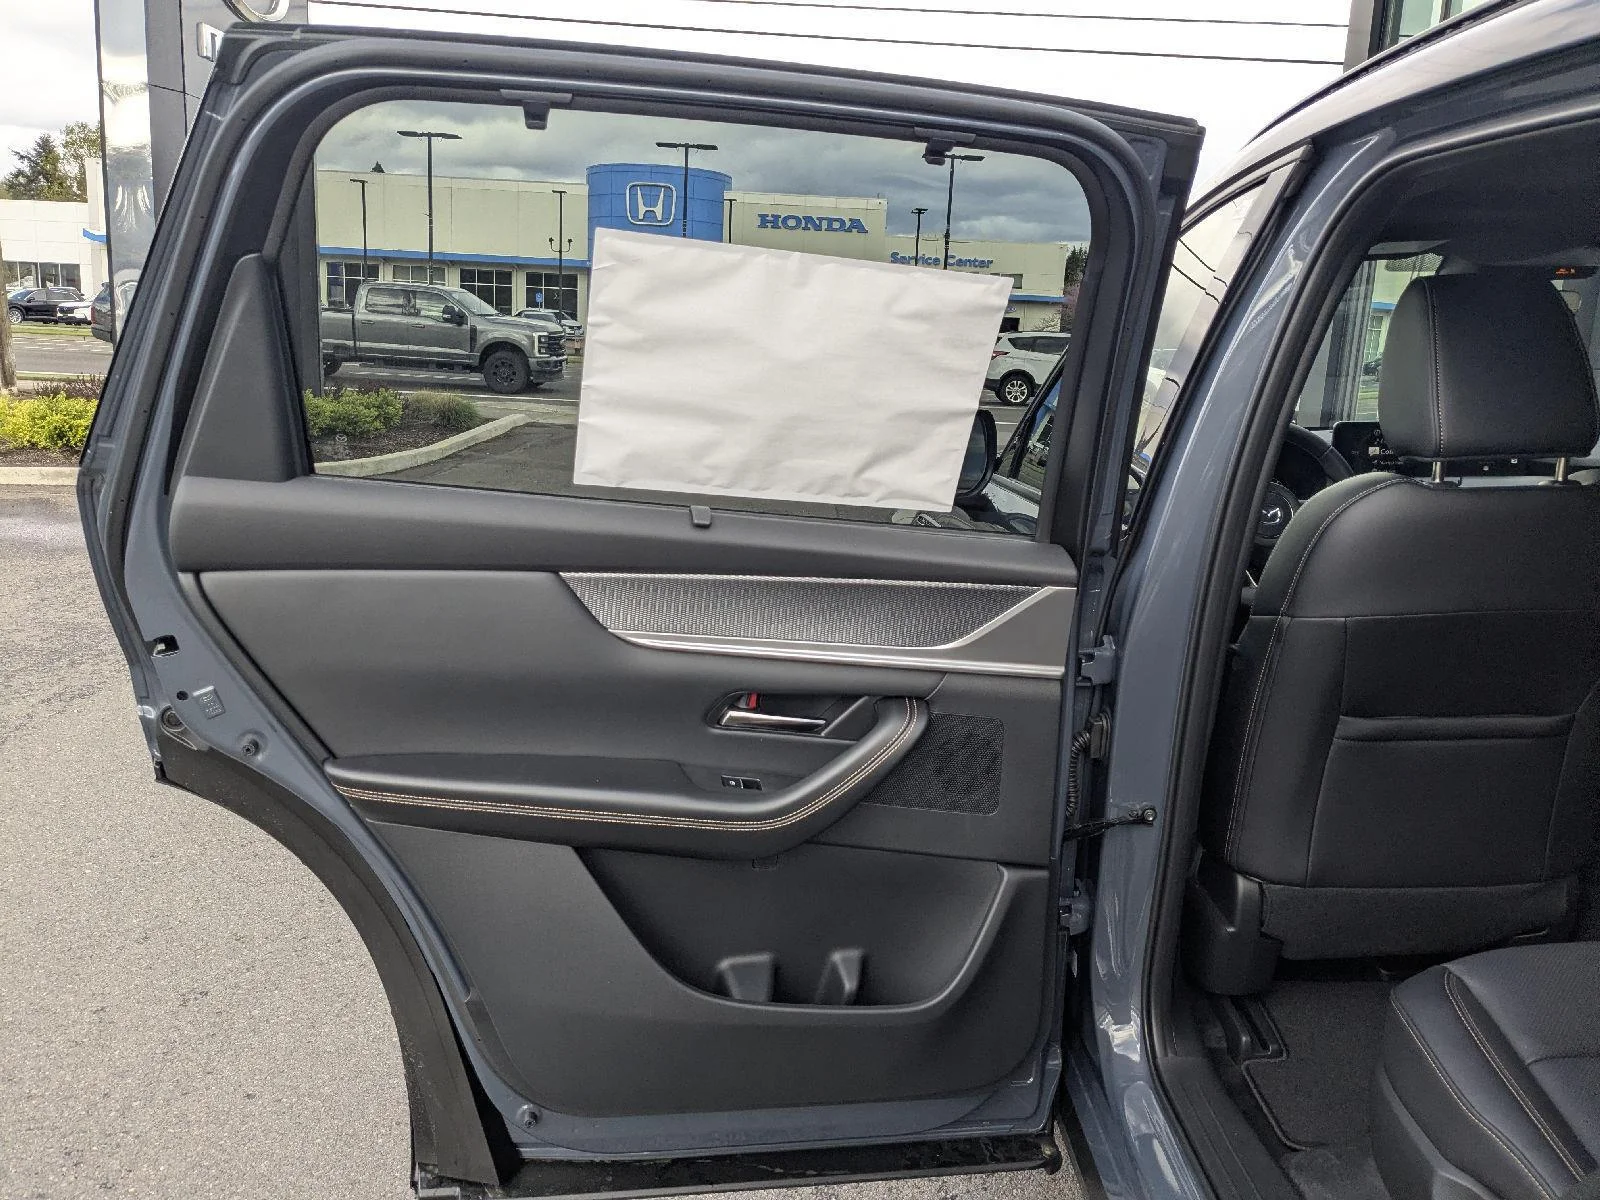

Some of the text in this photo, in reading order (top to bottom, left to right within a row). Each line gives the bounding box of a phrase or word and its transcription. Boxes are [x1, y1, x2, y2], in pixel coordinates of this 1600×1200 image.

[757, 213, 869, 234] HONDA
[890, 251, 994, 269] Service Center
